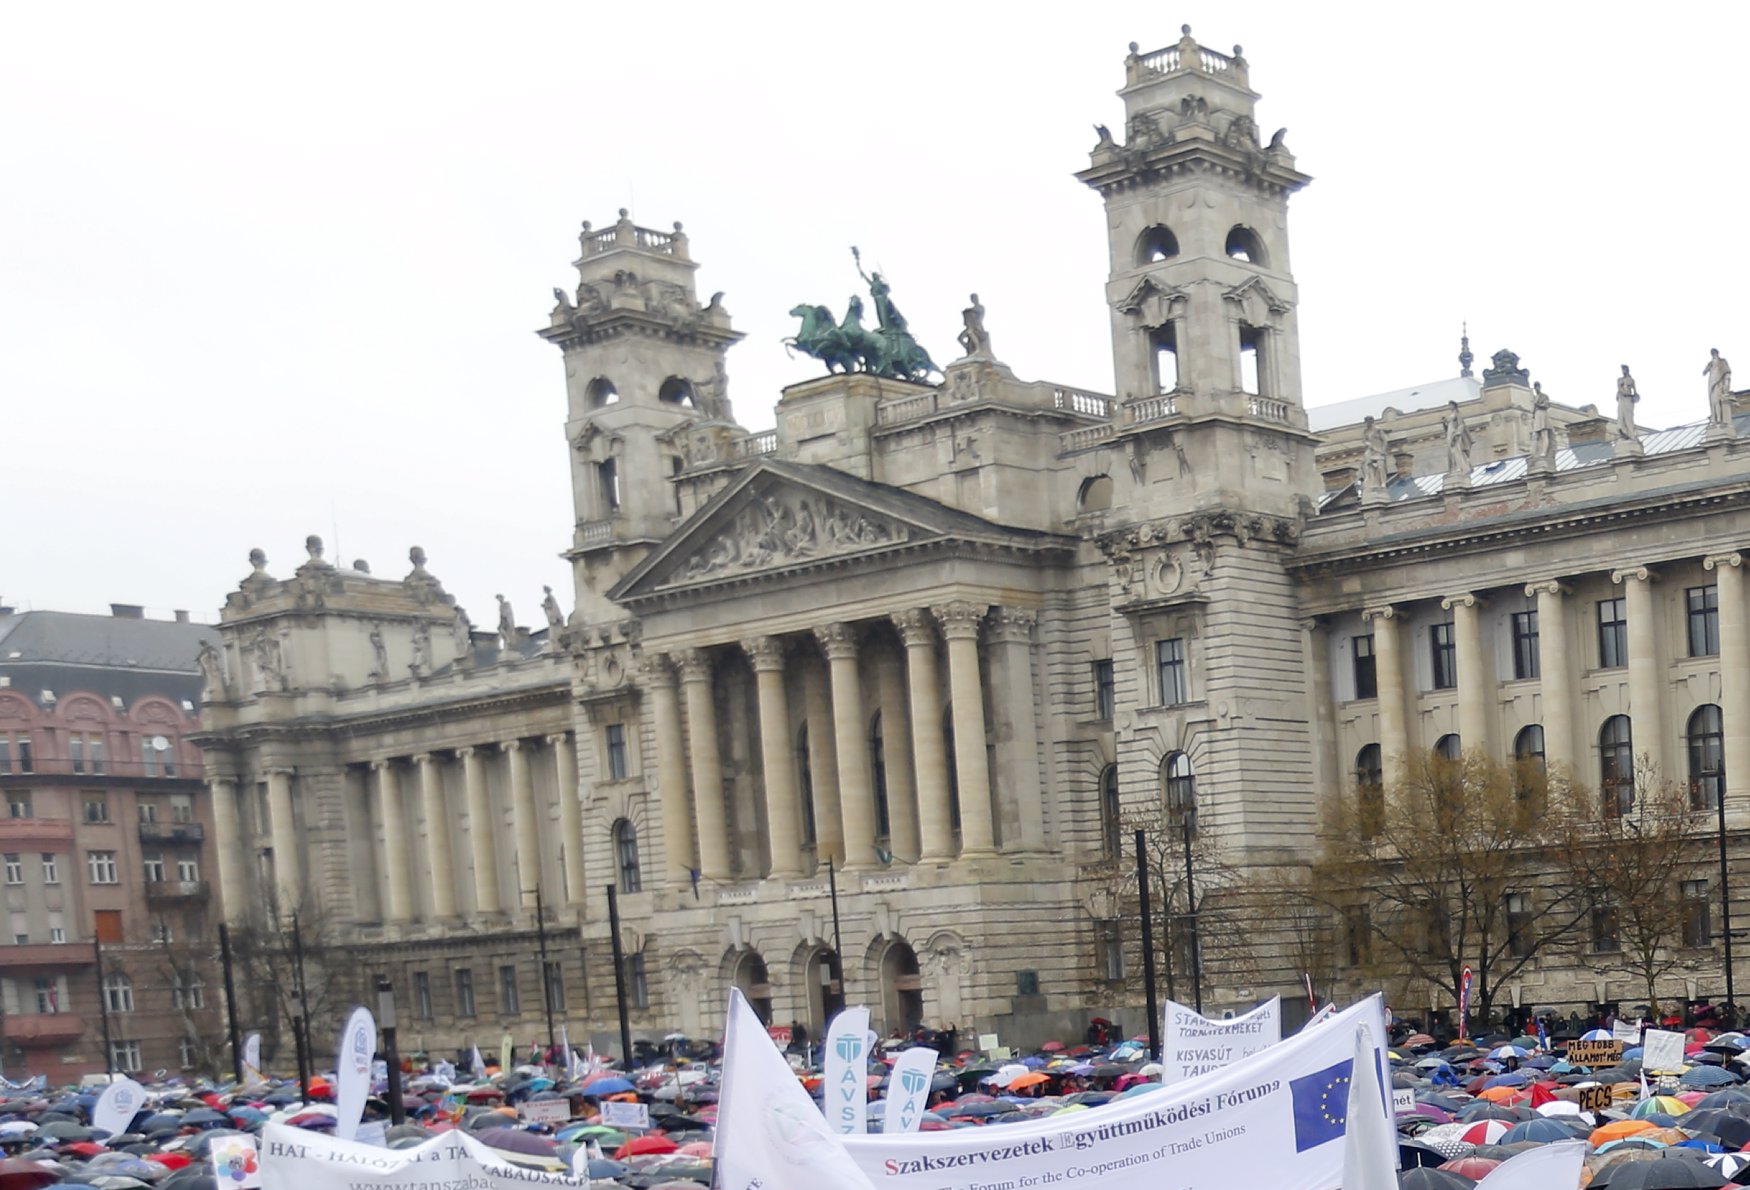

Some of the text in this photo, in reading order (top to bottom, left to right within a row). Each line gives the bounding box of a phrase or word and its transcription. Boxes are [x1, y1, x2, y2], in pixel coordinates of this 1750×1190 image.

[1176, 1044, 1233, 1061] KISVASÚT
[884, 1078, 1280, 1177] Szakszervezetek Együttműködési Fóruma
[270, 1142, 309, 1157] HAT
[1018, 1175, 1038, 1188] for
[1041, 1171, 1063, 1184] the
[1066, 1151, 1150, 1180] Co-operation
[1151, 1144, 1168, 1158] of
[1165, 1136, 1203, 1156] Trade
[1204, 1123, 1247, 1145] Unions
